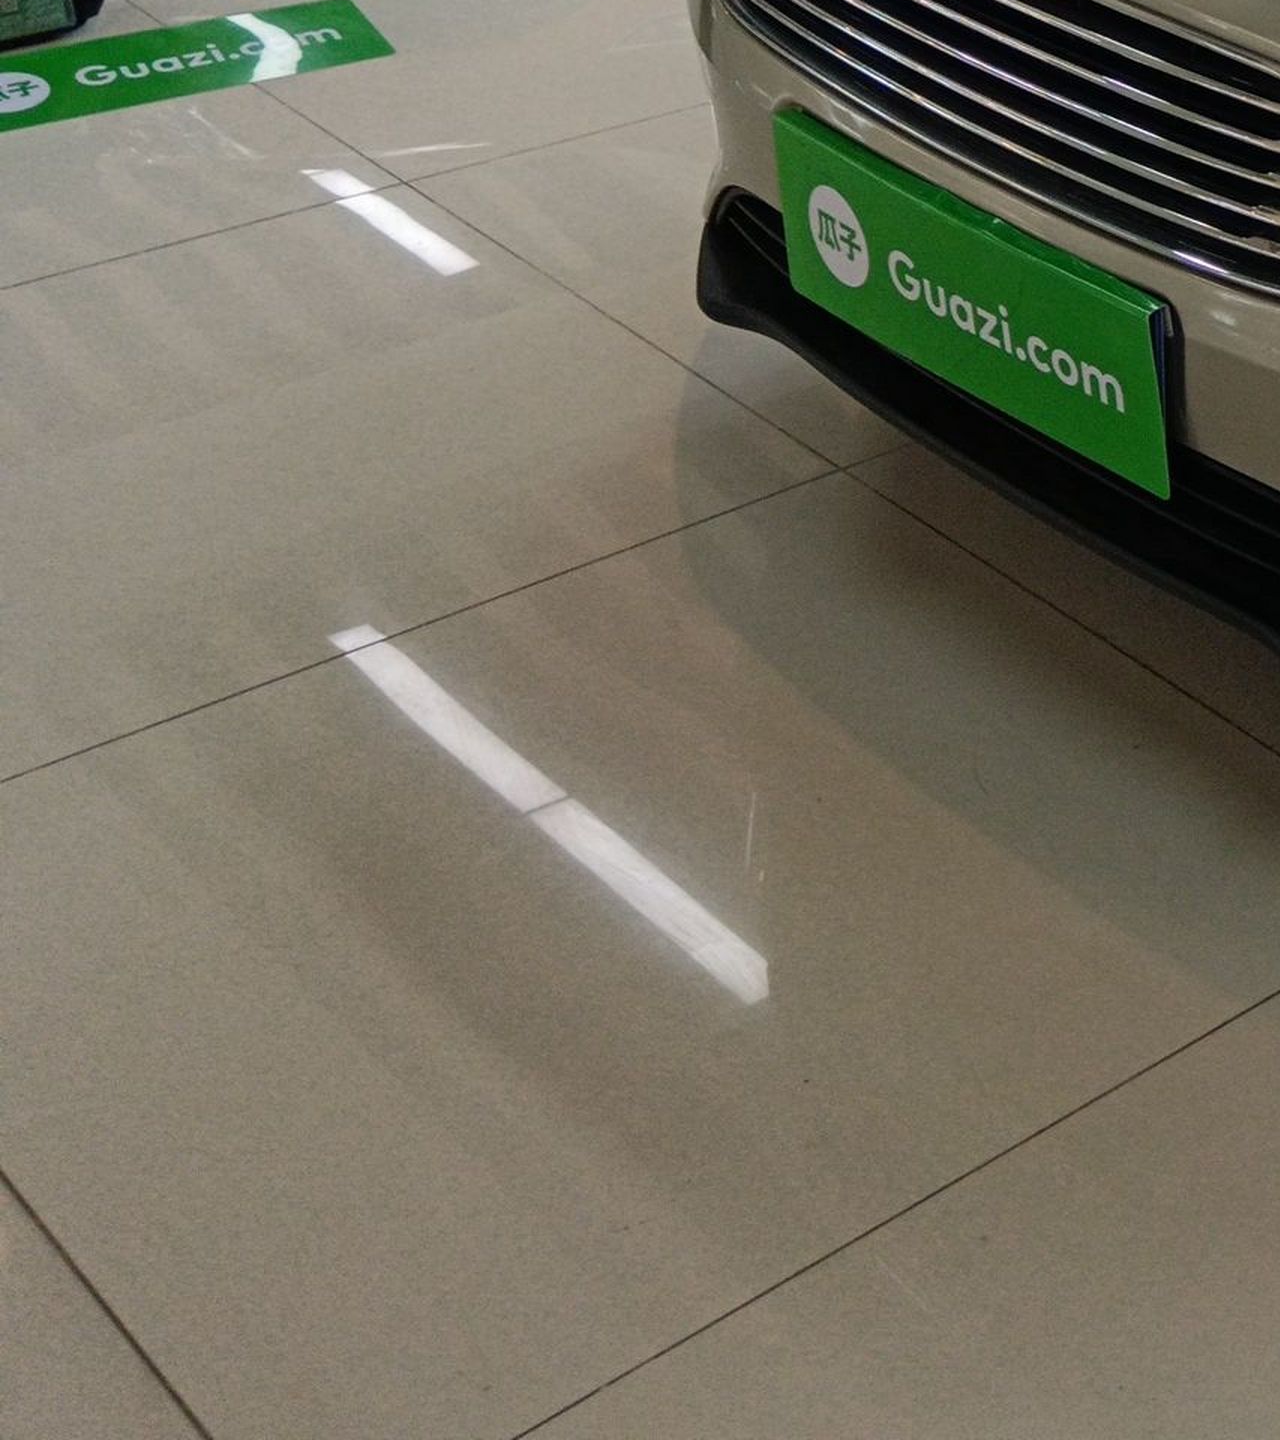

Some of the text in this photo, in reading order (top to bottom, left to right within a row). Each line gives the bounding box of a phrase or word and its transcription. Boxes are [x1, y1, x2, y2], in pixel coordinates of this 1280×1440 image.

[75, 27, 343, 86] Guazi.cm
[816, 207, 862, 262] 瓜子
[887, 250, 1125, 413] Guazi.com
